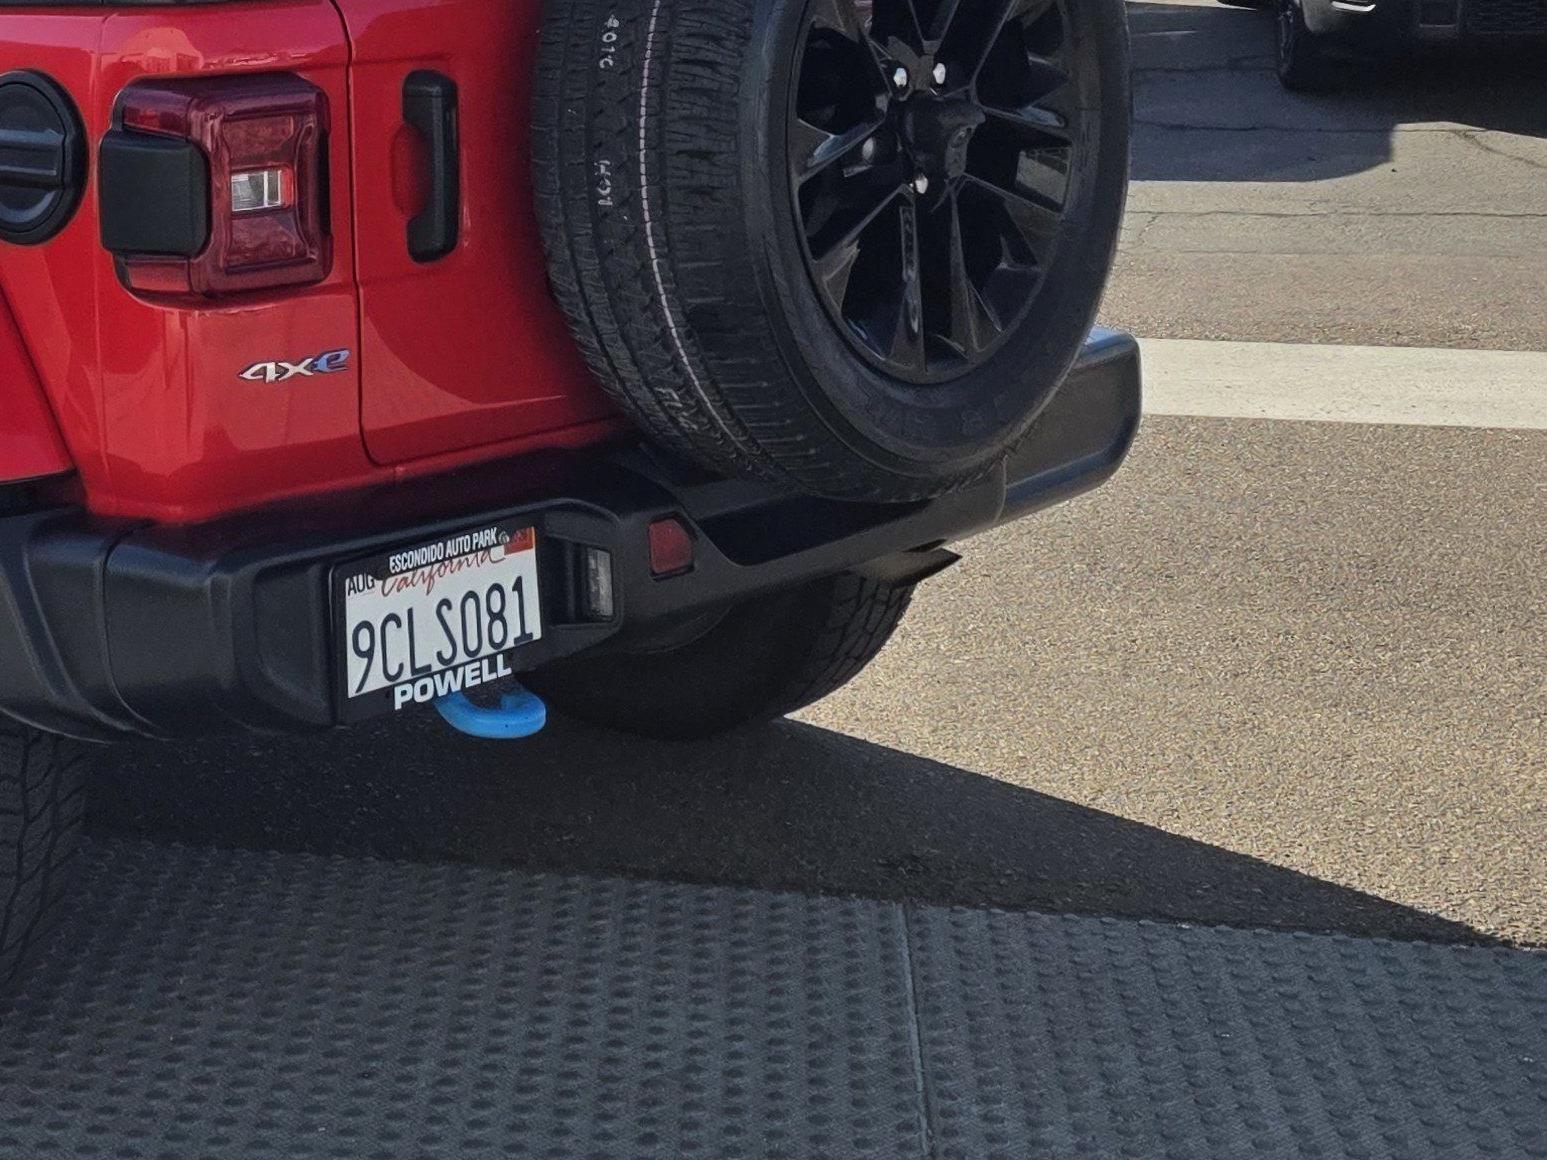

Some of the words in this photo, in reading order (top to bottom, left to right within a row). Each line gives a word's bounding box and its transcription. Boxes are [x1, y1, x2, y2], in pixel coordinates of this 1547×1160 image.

[347, 574, 375, 596] AUG
[381, 549, 506, 597] California
[389, 542, 444, 574] ESCONDIDO
[445, 535, 471, 558] AUTO
[472, 526, 498, 551] PARK
[351, 575, 534, 694] 9CLS081
[394, 654, 513, 710] POWELL
